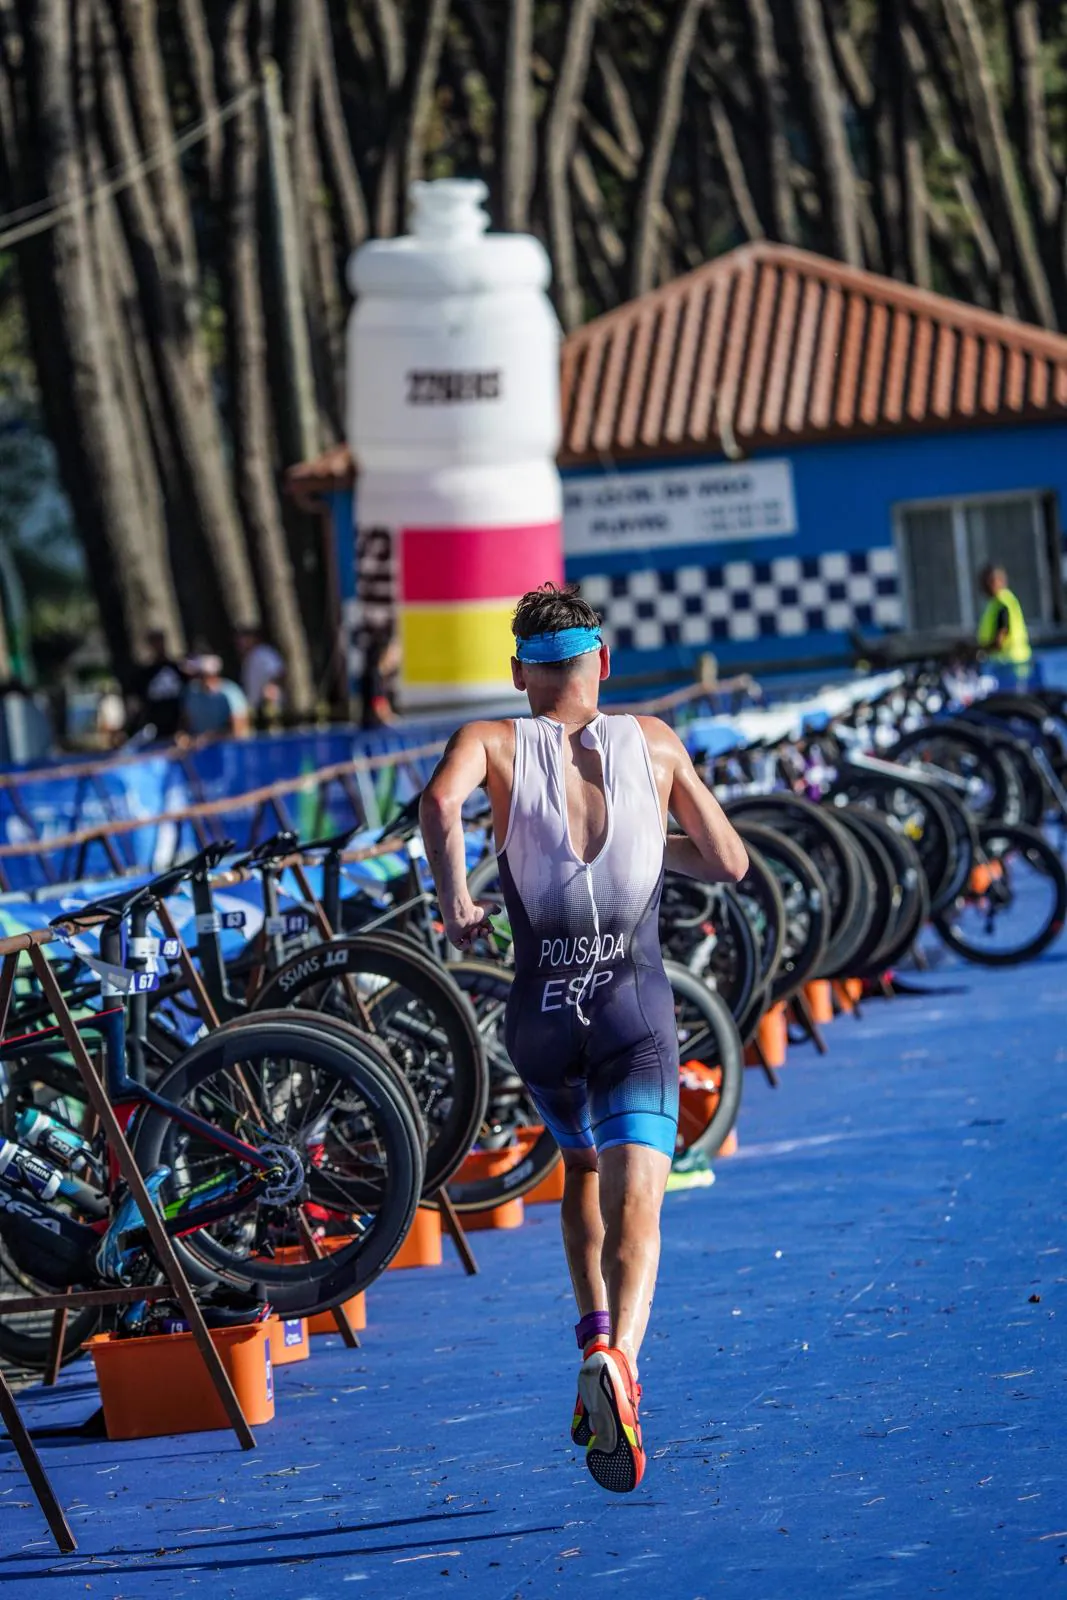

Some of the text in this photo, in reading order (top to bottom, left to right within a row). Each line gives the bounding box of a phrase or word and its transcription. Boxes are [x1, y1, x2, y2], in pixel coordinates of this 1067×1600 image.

[538, 933, 625, 968] POUSADA
[138, 973, 155, 990] 67
[278, 949, 349, 993] DT SWISS
[541, 970, 614, 1013] ESP
[15, 1155, 50, 1179] GRMIN
